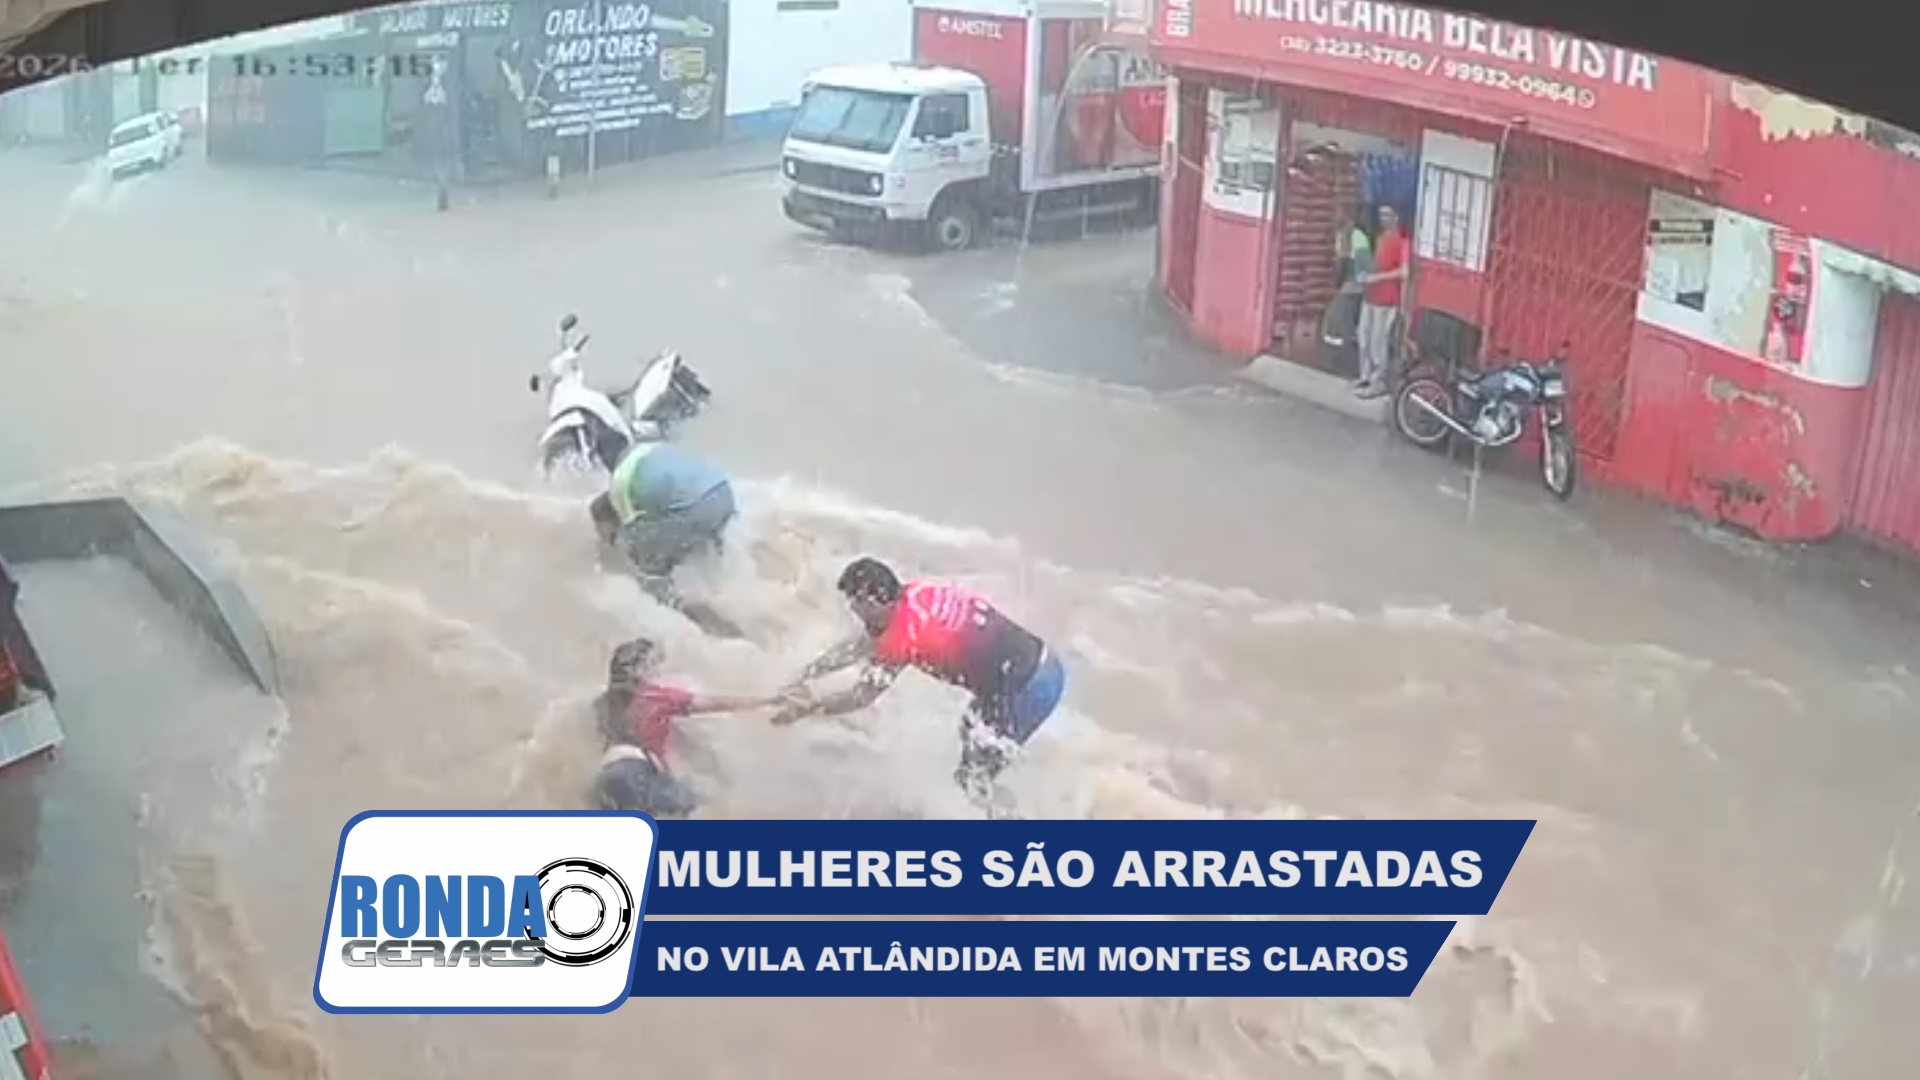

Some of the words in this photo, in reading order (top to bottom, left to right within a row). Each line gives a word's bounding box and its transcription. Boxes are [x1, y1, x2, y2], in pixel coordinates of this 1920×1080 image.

[545, 4, 650, 36] ORLANDO
[553, 32, 658, 64] MOTORES
[1444, 13, 1534, 63] BELA
[1547, 30, 1654, 91] VISTA
